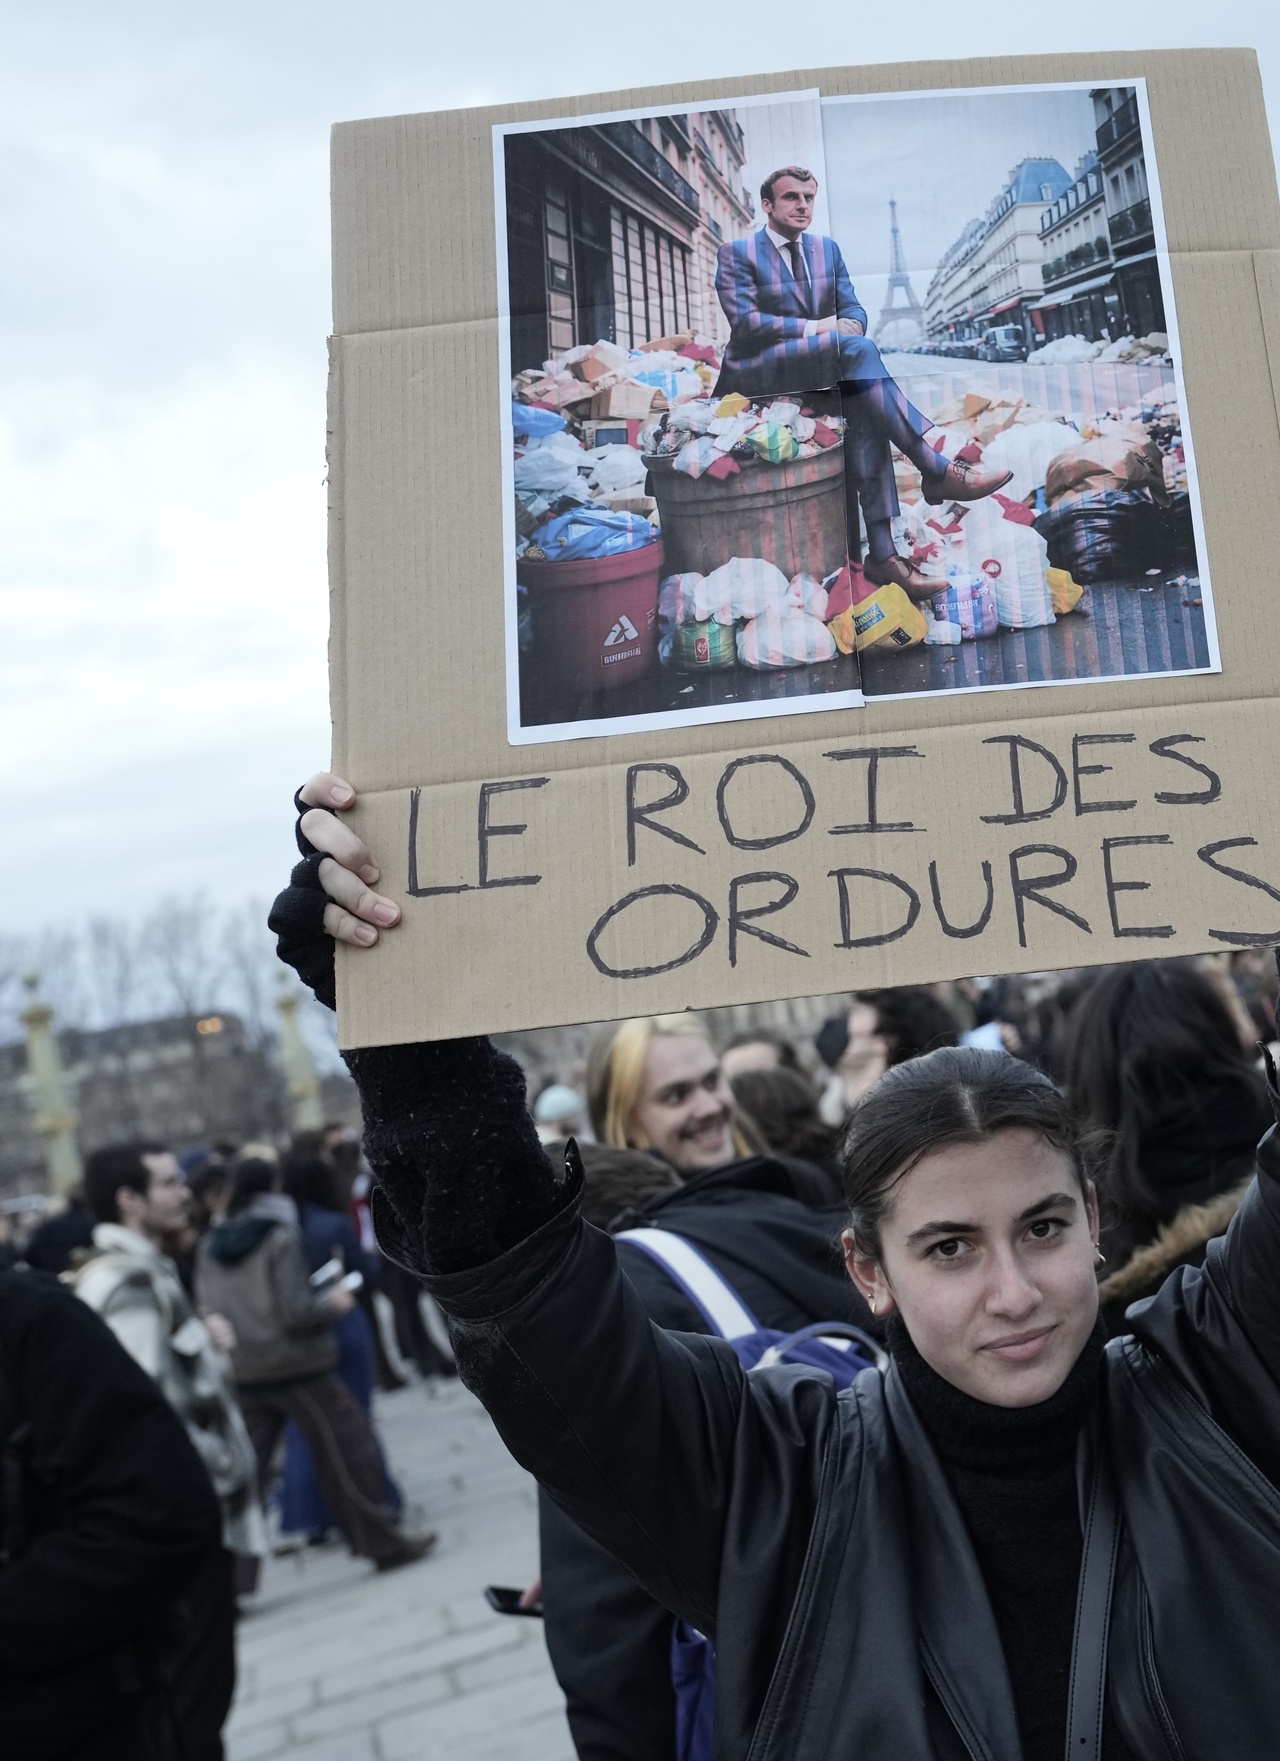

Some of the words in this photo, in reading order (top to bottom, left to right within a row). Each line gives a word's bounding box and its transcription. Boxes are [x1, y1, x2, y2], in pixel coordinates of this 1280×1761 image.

[406, 777, 551, 897] LE
[627, 745, 928, 867] ROI
[980, 734, 1222, 826] DES
